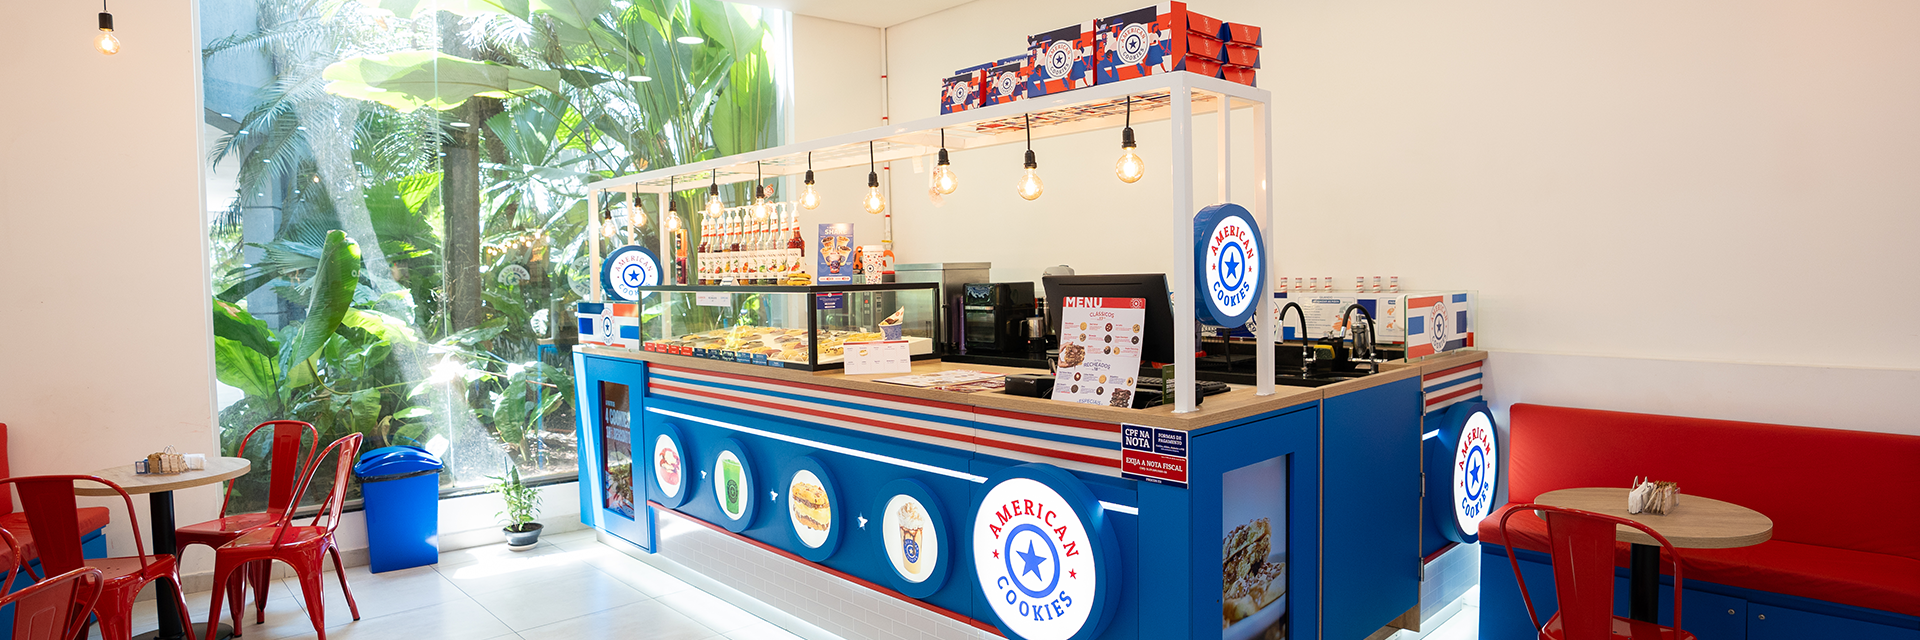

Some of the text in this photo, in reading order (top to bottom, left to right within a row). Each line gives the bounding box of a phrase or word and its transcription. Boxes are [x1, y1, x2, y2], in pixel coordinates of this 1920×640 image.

[1211, 225, 1254, 259] AMERICAN
[615, 255, 653, 272] AMERICAN
[1065, 296, 1103, 309] MENU
[1213, 281, 1250, 307] COOKIES
[1125, 428, 1150, 439] CPF NA
[1125, 436, 1150, 448] NOTA
[1458, 427, 1491, 471] AMERICAN
[1146, 460, 1162, 469] NOTA
[1162, 463, 1183, 472] FISCAL
[1462, 481, 1490, 519] COOKIES
[989, 499, 1079, 557] AMERICAN
[997, 575, 1073, 621] COOKIES
